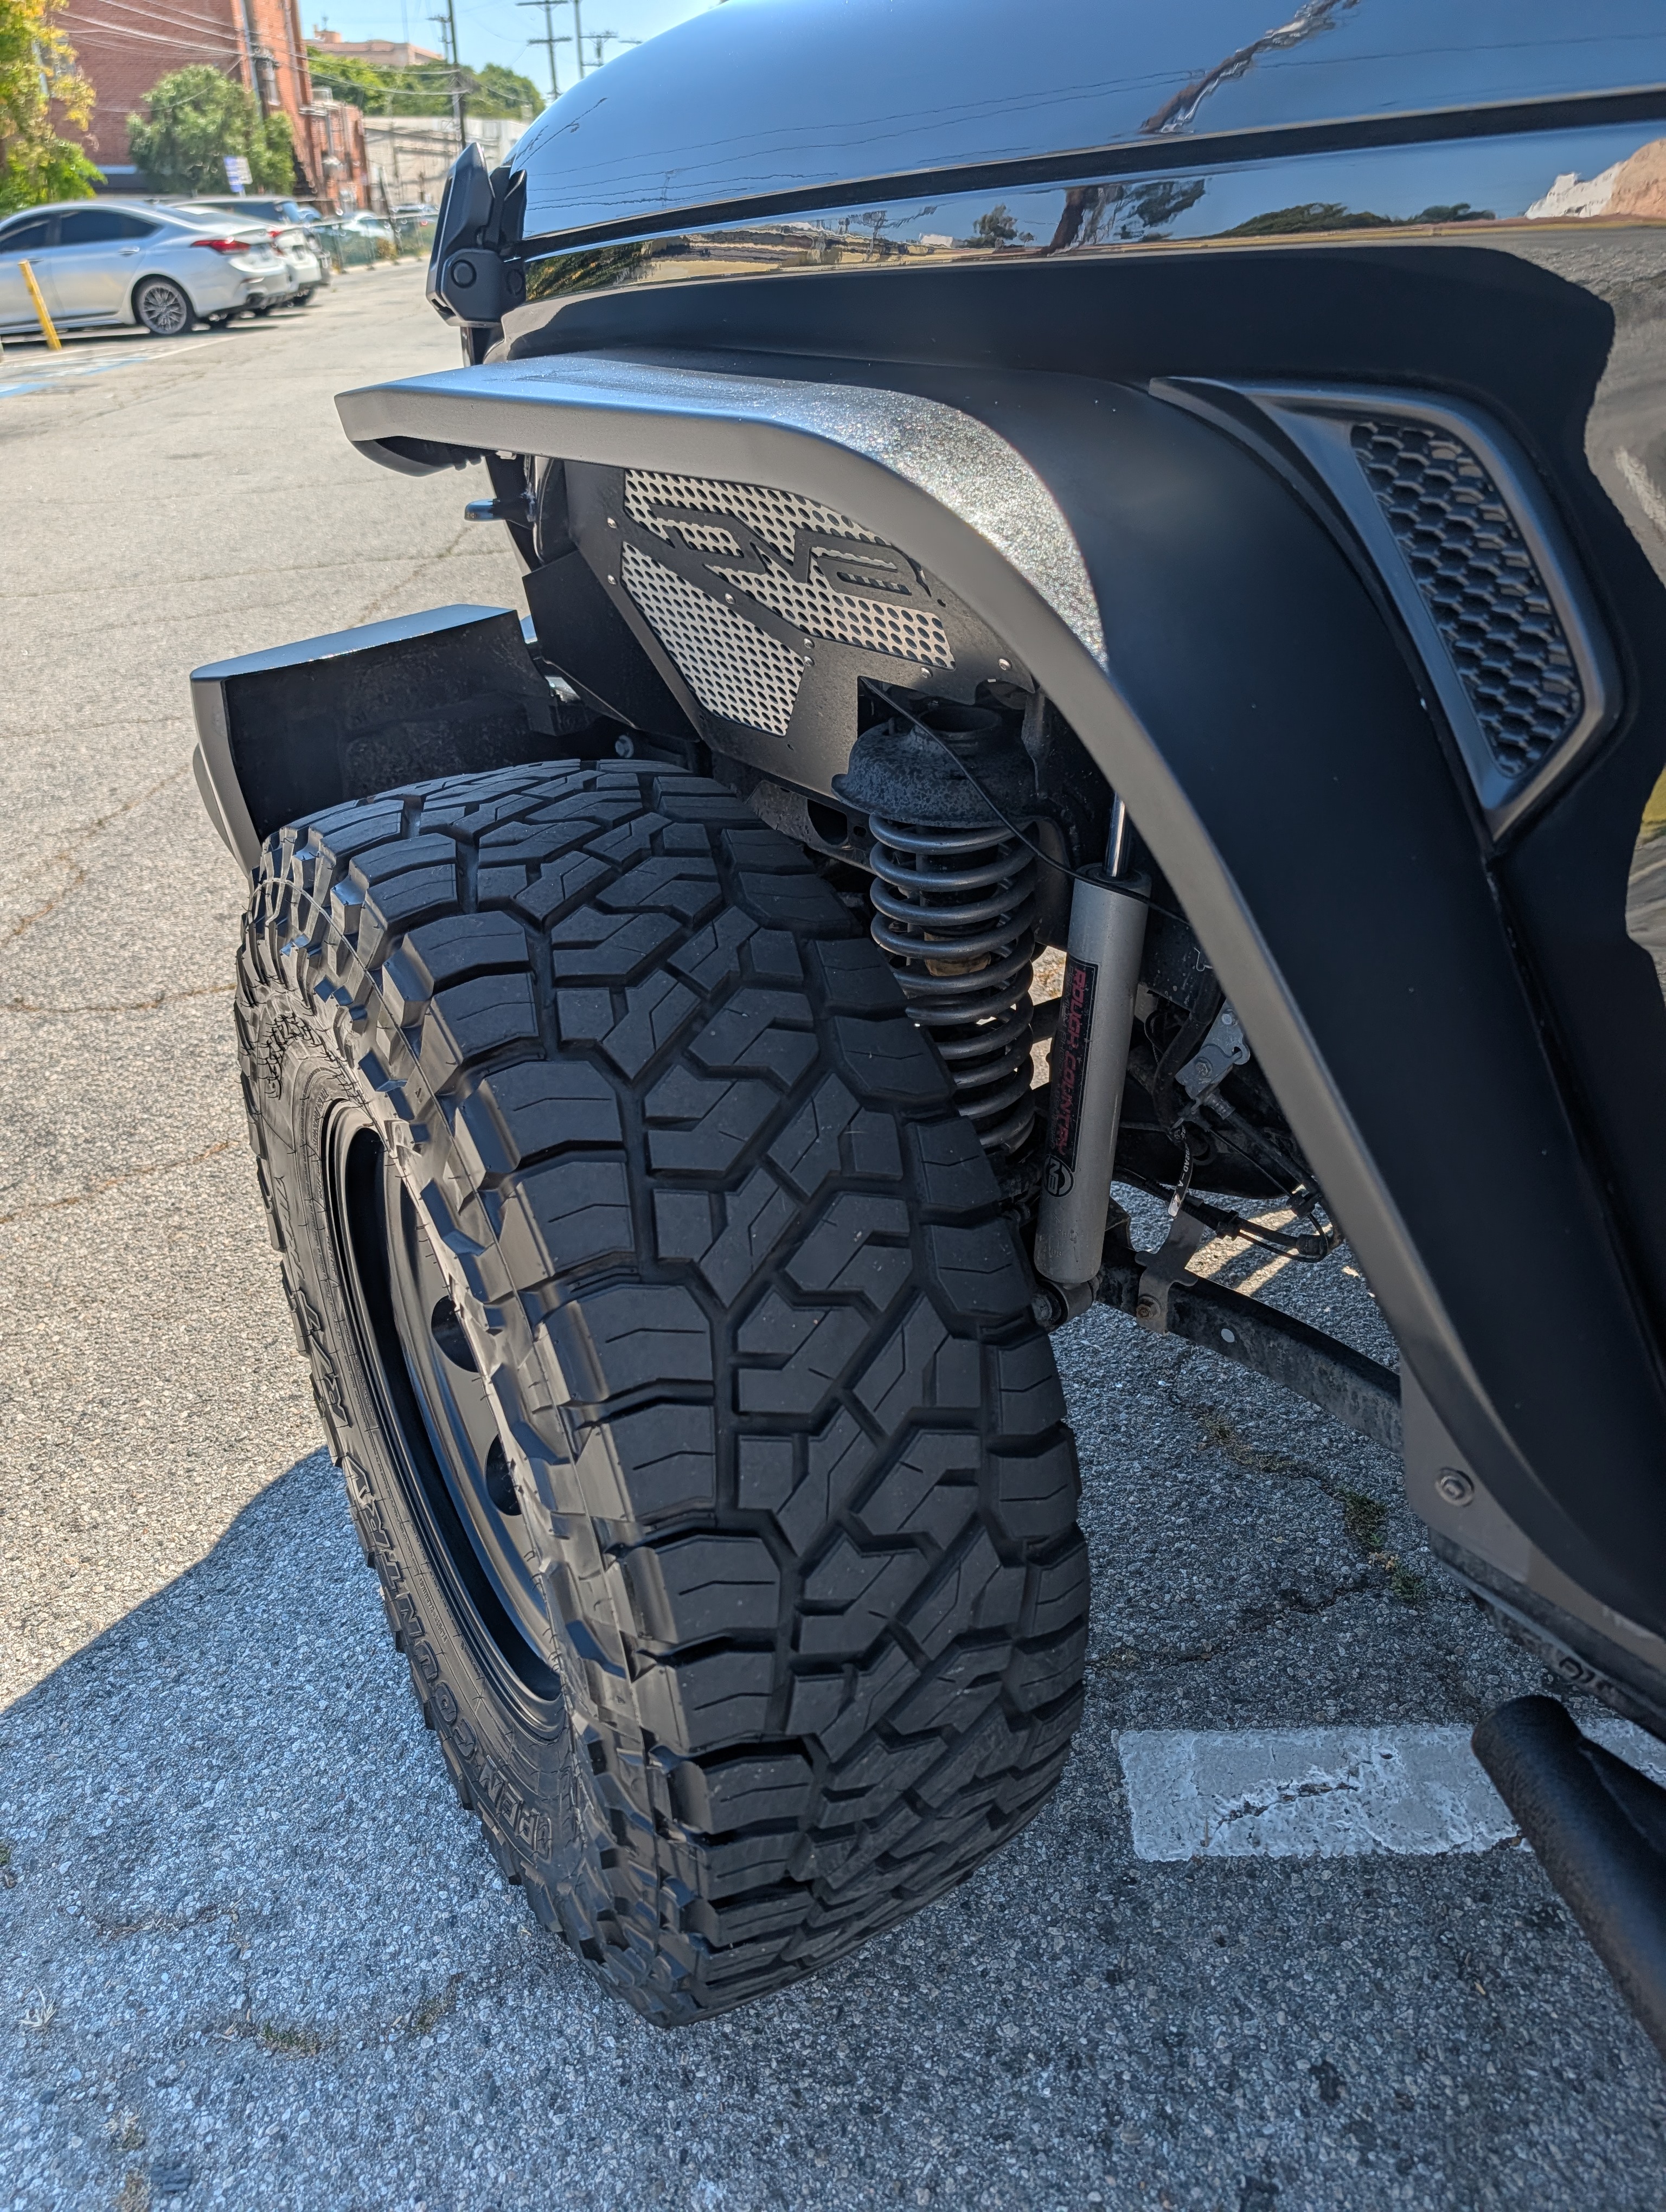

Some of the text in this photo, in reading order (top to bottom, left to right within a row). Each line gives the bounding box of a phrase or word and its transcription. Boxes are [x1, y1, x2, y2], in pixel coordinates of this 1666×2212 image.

[1057, 969, 1086, 1155] ROUGH COUNTRY
[1062, 966, 1074, 1026] PREMIUM
[299, 1290, 353, 1429] R/T
[346, 1452, 477, 1759] COUNTRY
[476, 1756, 552, 1863] OPEN
